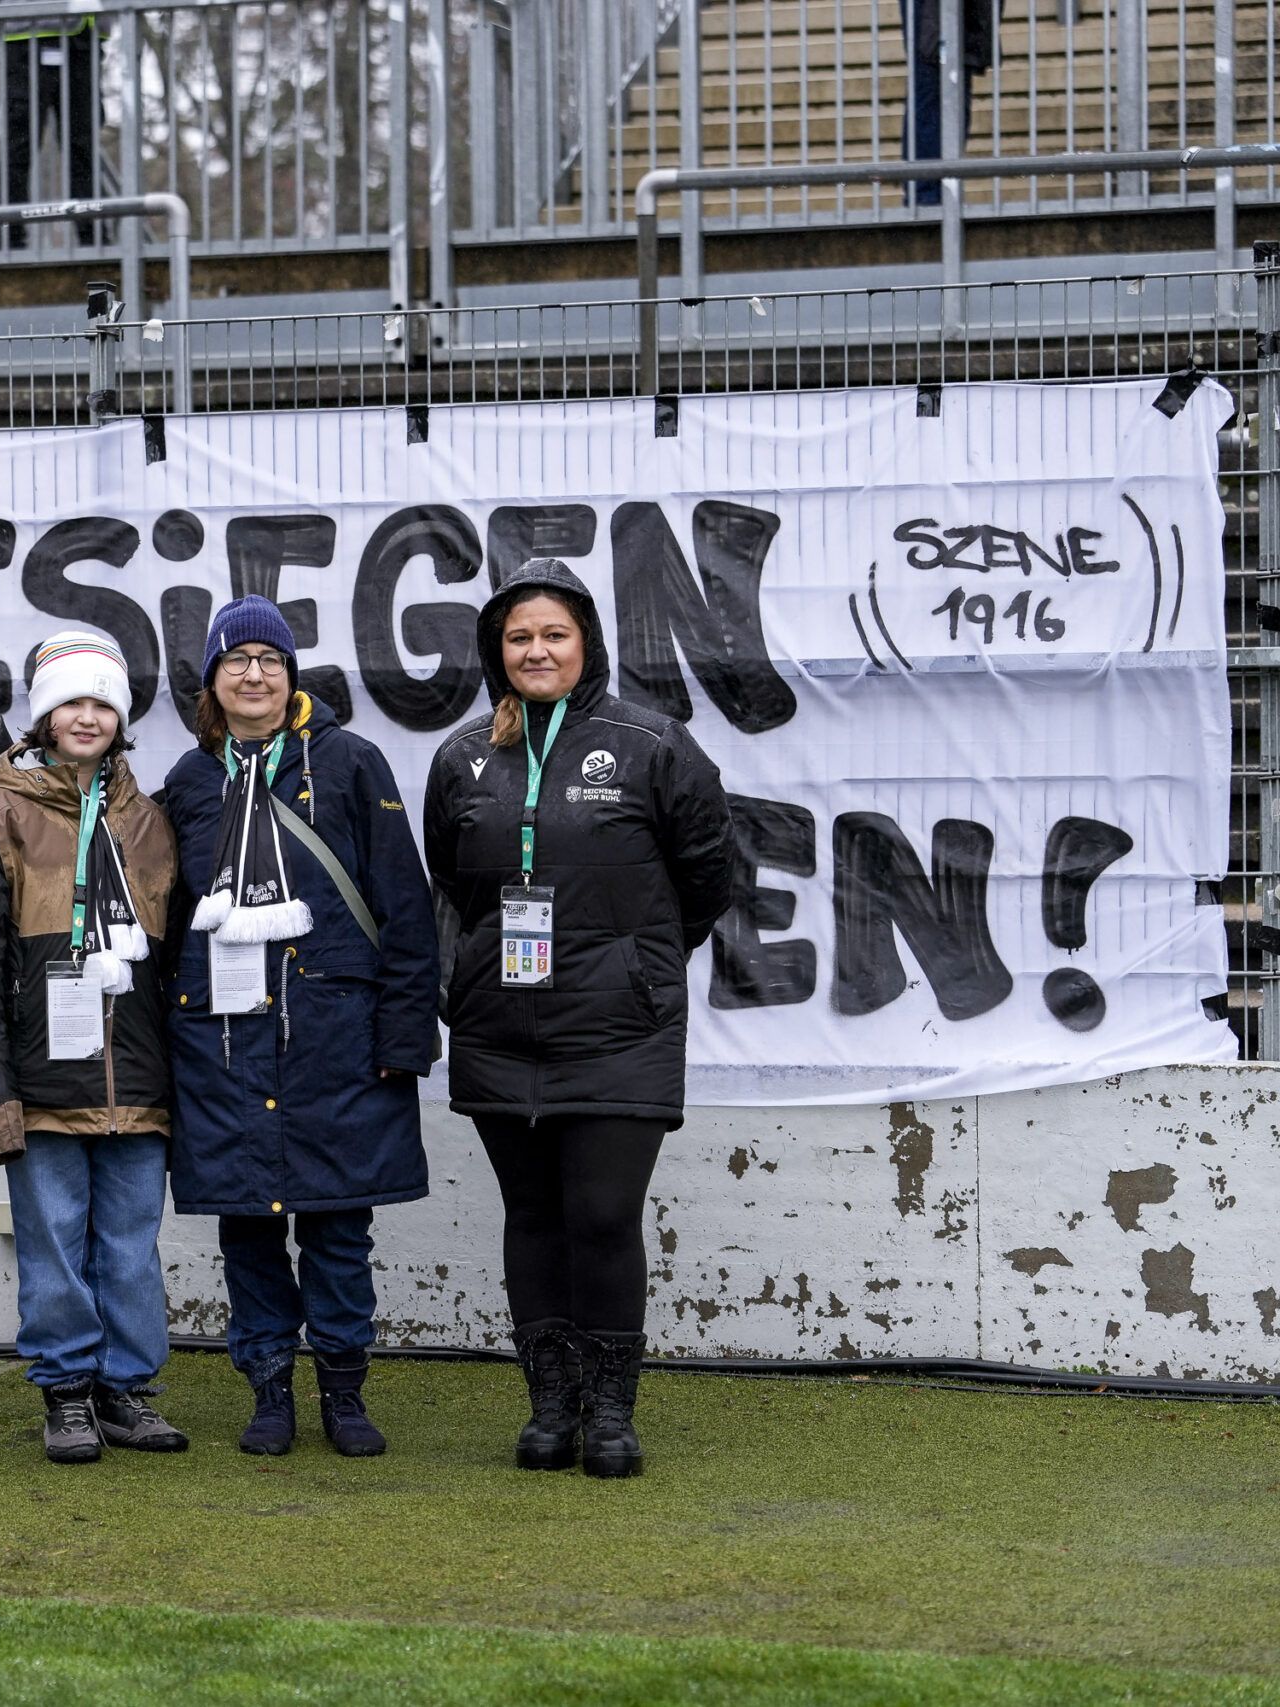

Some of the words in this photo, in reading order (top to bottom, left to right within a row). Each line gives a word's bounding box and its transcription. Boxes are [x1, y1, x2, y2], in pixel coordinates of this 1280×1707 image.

[893, 518, 1120, 577] SZENE
[932, 586, 1066, 644] 1916
[586, 754, 606, 769] SV
[583, 788, 622, 796] REICHSRAT
